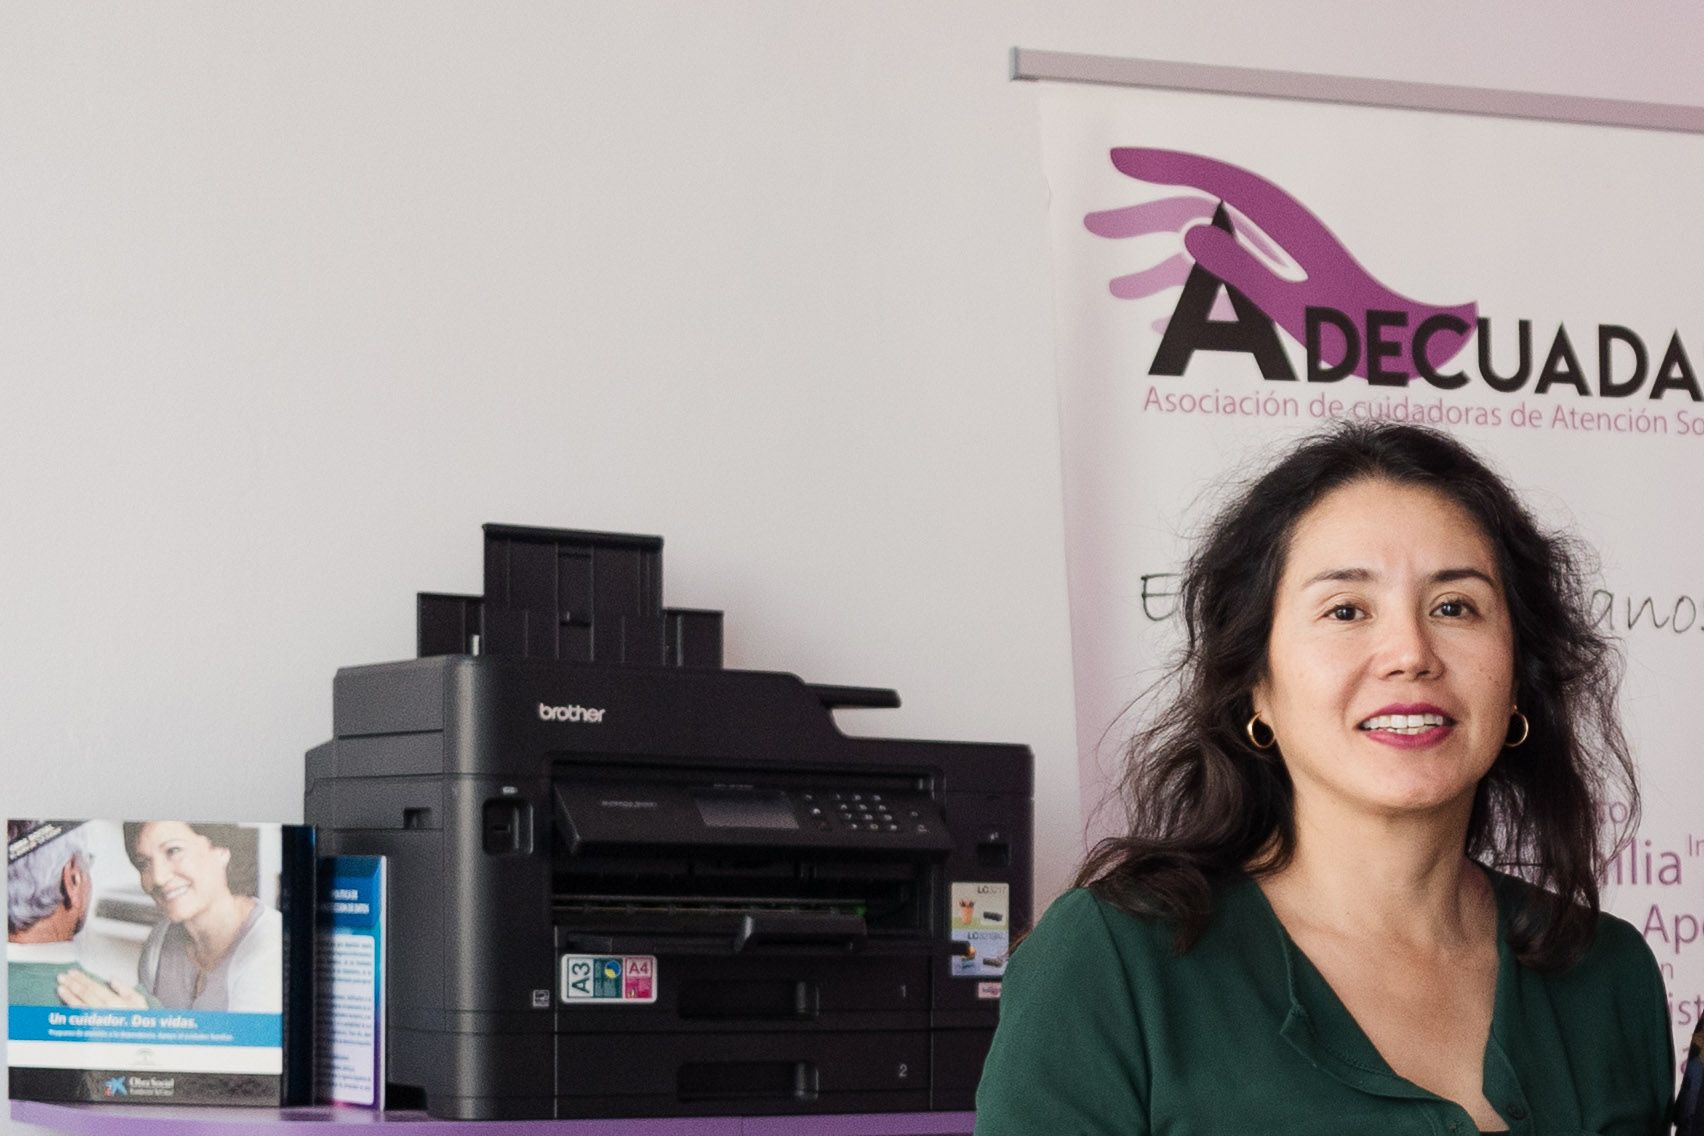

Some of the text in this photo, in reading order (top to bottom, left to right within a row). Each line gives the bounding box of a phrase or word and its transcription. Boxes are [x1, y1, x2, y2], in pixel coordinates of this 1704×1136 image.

[1143, 386, 1300, 418] Asociación
[1308, 391, 1344, 419] de
[1510, 401, 1544, 428] de
[1551, 403, 1668, 434] Atención
[538, 702, 606, 722] brother
[571, 962, 591, 994] A3
[628, 961, 649, 975] A4
[48, 1012, 199, 1030] Un cuidador. Dos vidas.
